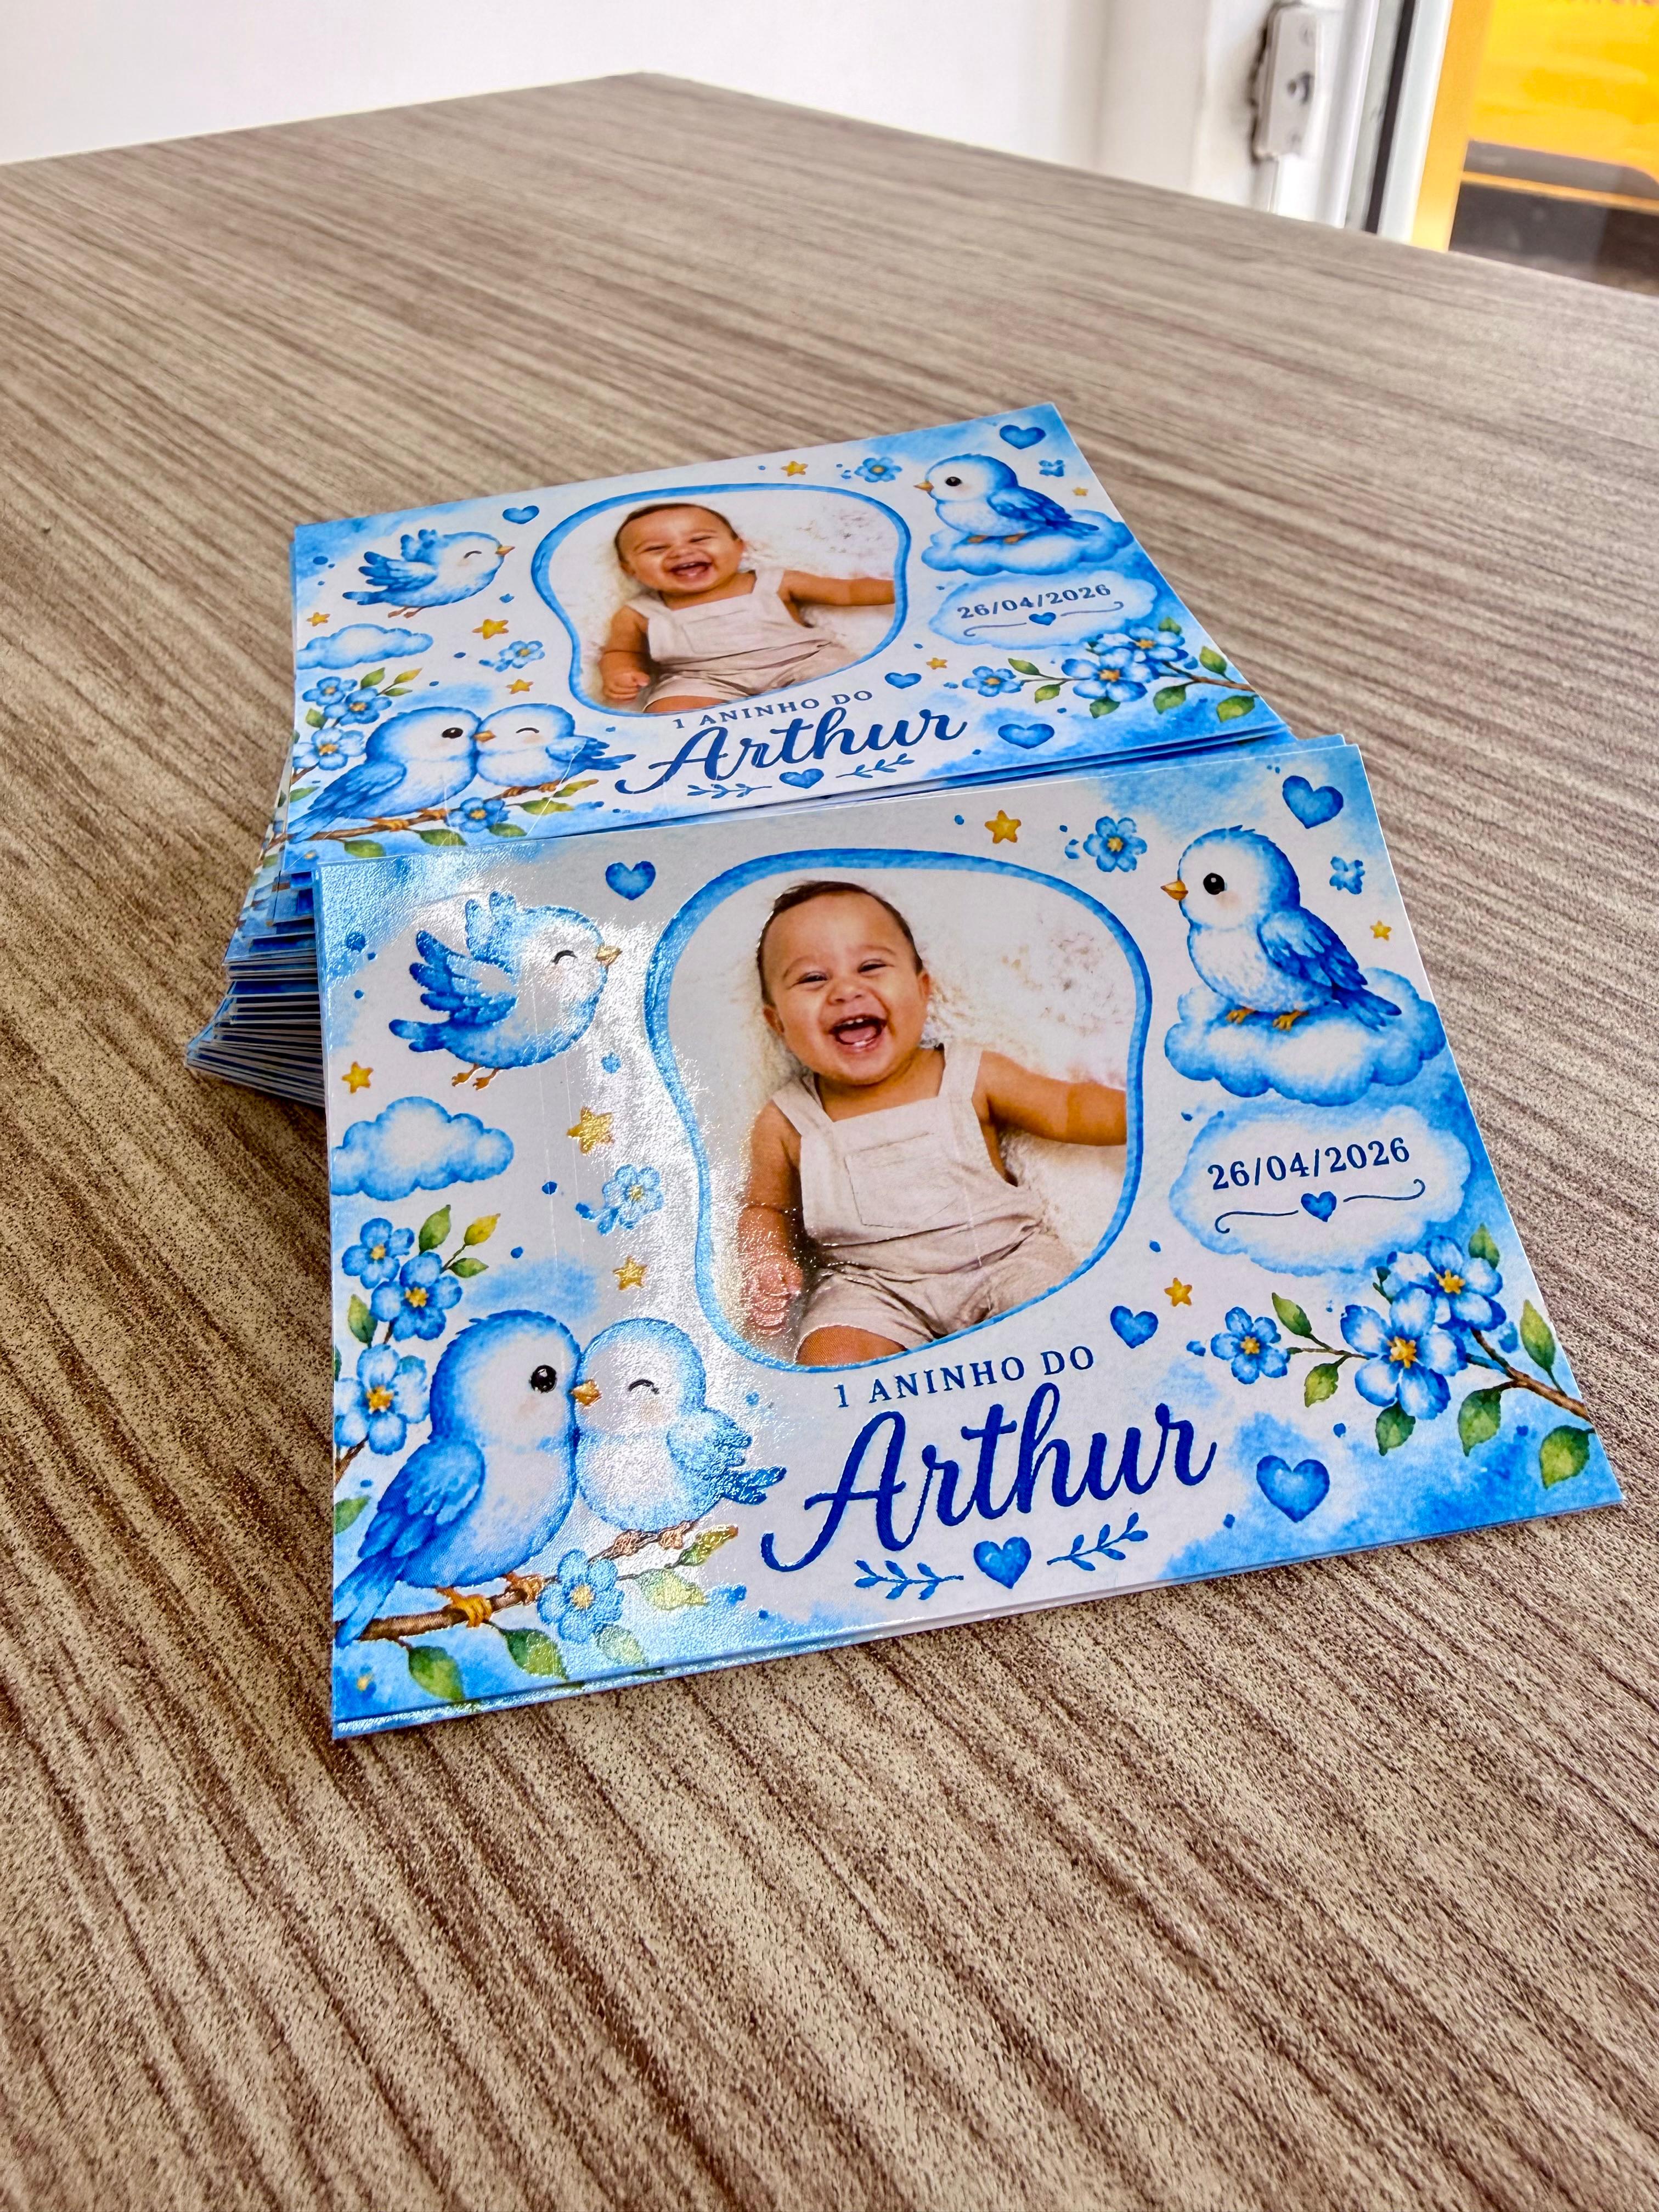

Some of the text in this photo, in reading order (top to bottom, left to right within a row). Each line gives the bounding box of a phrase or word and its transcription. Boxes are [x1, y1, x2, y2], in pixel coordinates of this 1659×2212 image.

[957, 584, 1111, 619] 26/04/2026
[672, 690, 873, 729] 1 ANINHO DO
[614, 707, 968, 794] Arthur
[1207, 1137, 1410, 1190] 26/04/2026
[833, 1345, 1094, 1408] 1 ANINHO DO
[760, 1381, 1217, 1573] Arthur
